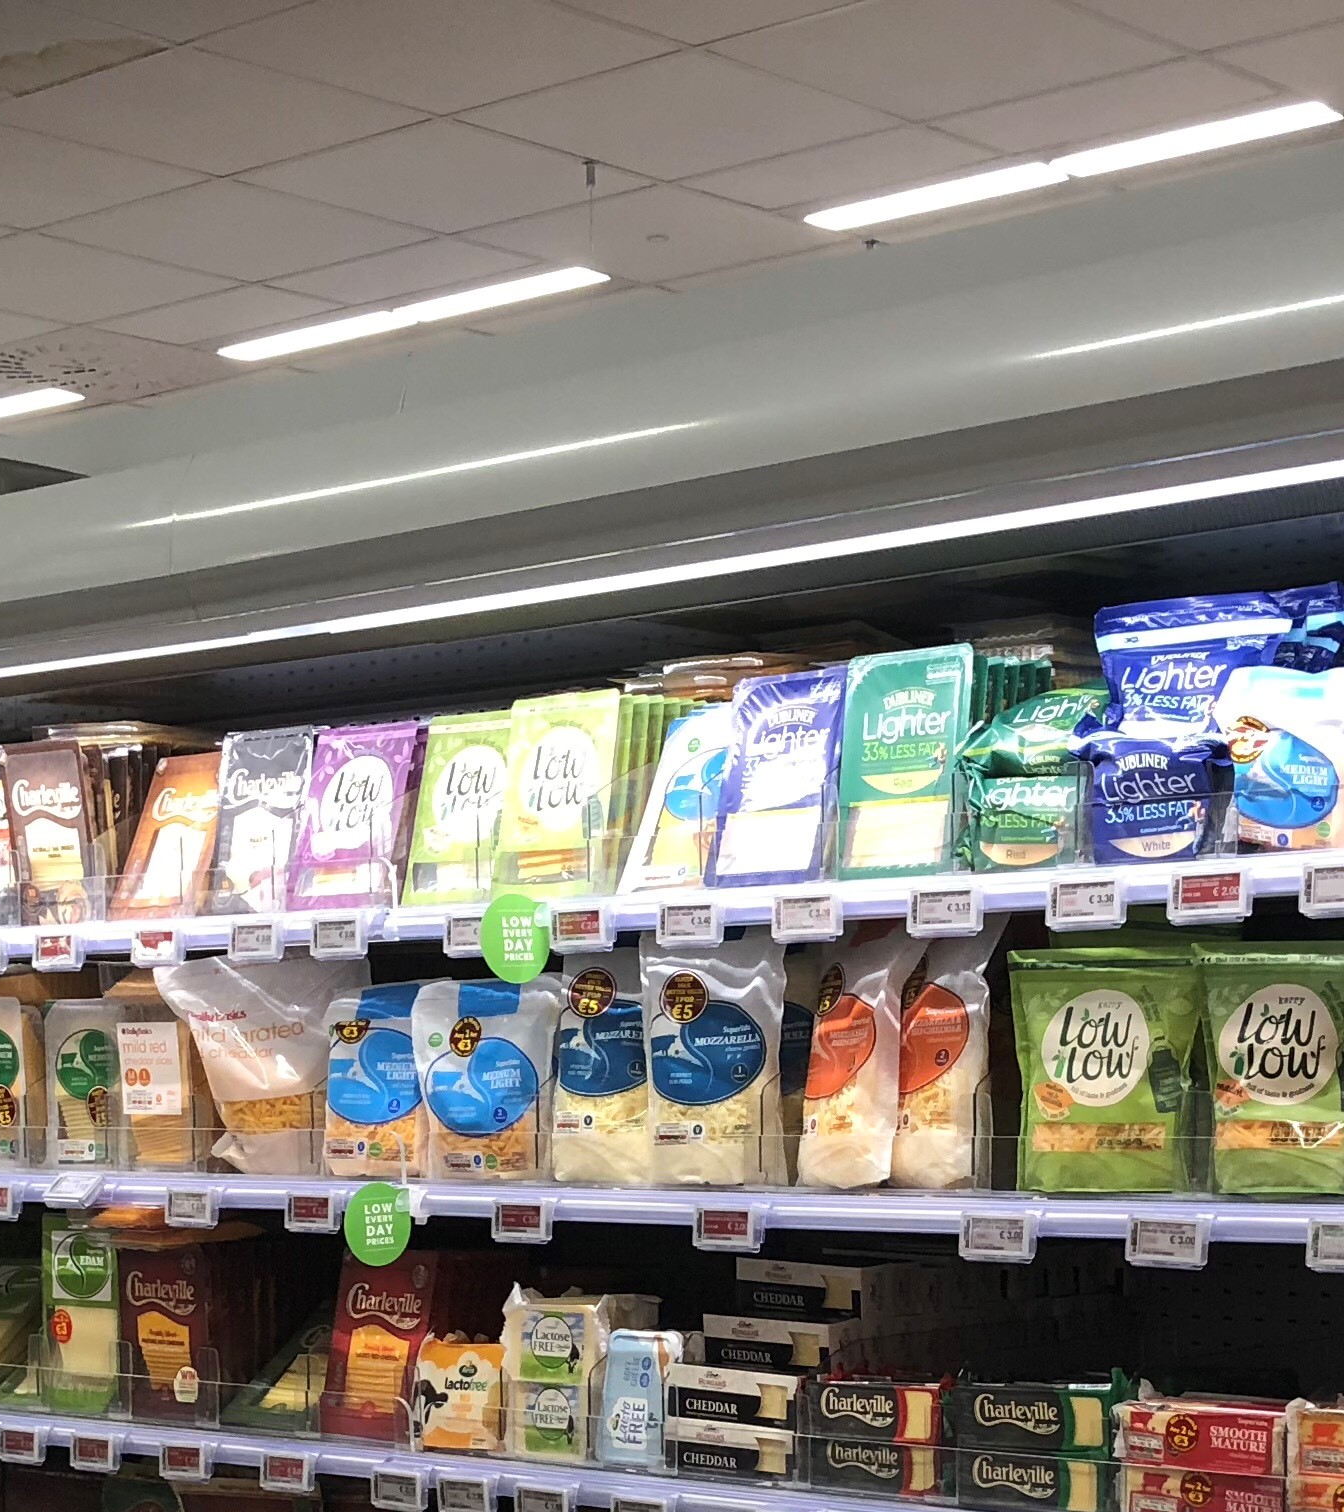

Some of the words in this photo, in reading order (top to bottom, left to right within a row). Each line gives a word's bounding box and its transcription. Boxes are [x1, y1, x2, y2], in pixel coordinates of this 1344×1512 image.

[1121, 662, 1227, 693] Lighter
[884, 690, 936, 709] DUBLINER
[862, 708, 951, 745] Lighter
[862, 744, 887, 762] 33%
[890, 744, 915, 758] LESS
[1100, 770, 1196, 803] Lighter
[12, 779, 81, 820] Charleville
[1105, 803, 1134, 823] 33%
[1137, 805, 1165, 820] LESS
[1168, 802, 1188, 818] FAT
[1142, 840, 1171, 852] White
[501, 916, 532, 928] LOW
[504, 939, 533, 952] DAY
[578, 998, 598, 1013] €5
[670, 1003, 692, 1019] €5
[694, 1033, 761, 1047] MOZZARELLA
[364, 1202, 391, 1213] LOW
[365, 1224, 393, 1236] DAY
[127, 1271, 195, 1314] Charleville
[347, 1283, 422, 1328] Charleville
[535, 1328, 571, 1342] Lactose
[533, 1340, 556, 1351] FREE
[444, 1376, 488, 1392] lactofree
[686, 1399, 738, 1415] CHEDDAR
[821, 1387, 894, 1426] Charleville
[975, 1394, 1060, 1434] Charleville
[1210, 1426, 1267, 1442] SMOOTH
[1212, 1438, 1266, 1453] MATURE
[683, 1453, 738, 1468] CHEDDAR
[973, 1455, 1055, 1498] Charleville
